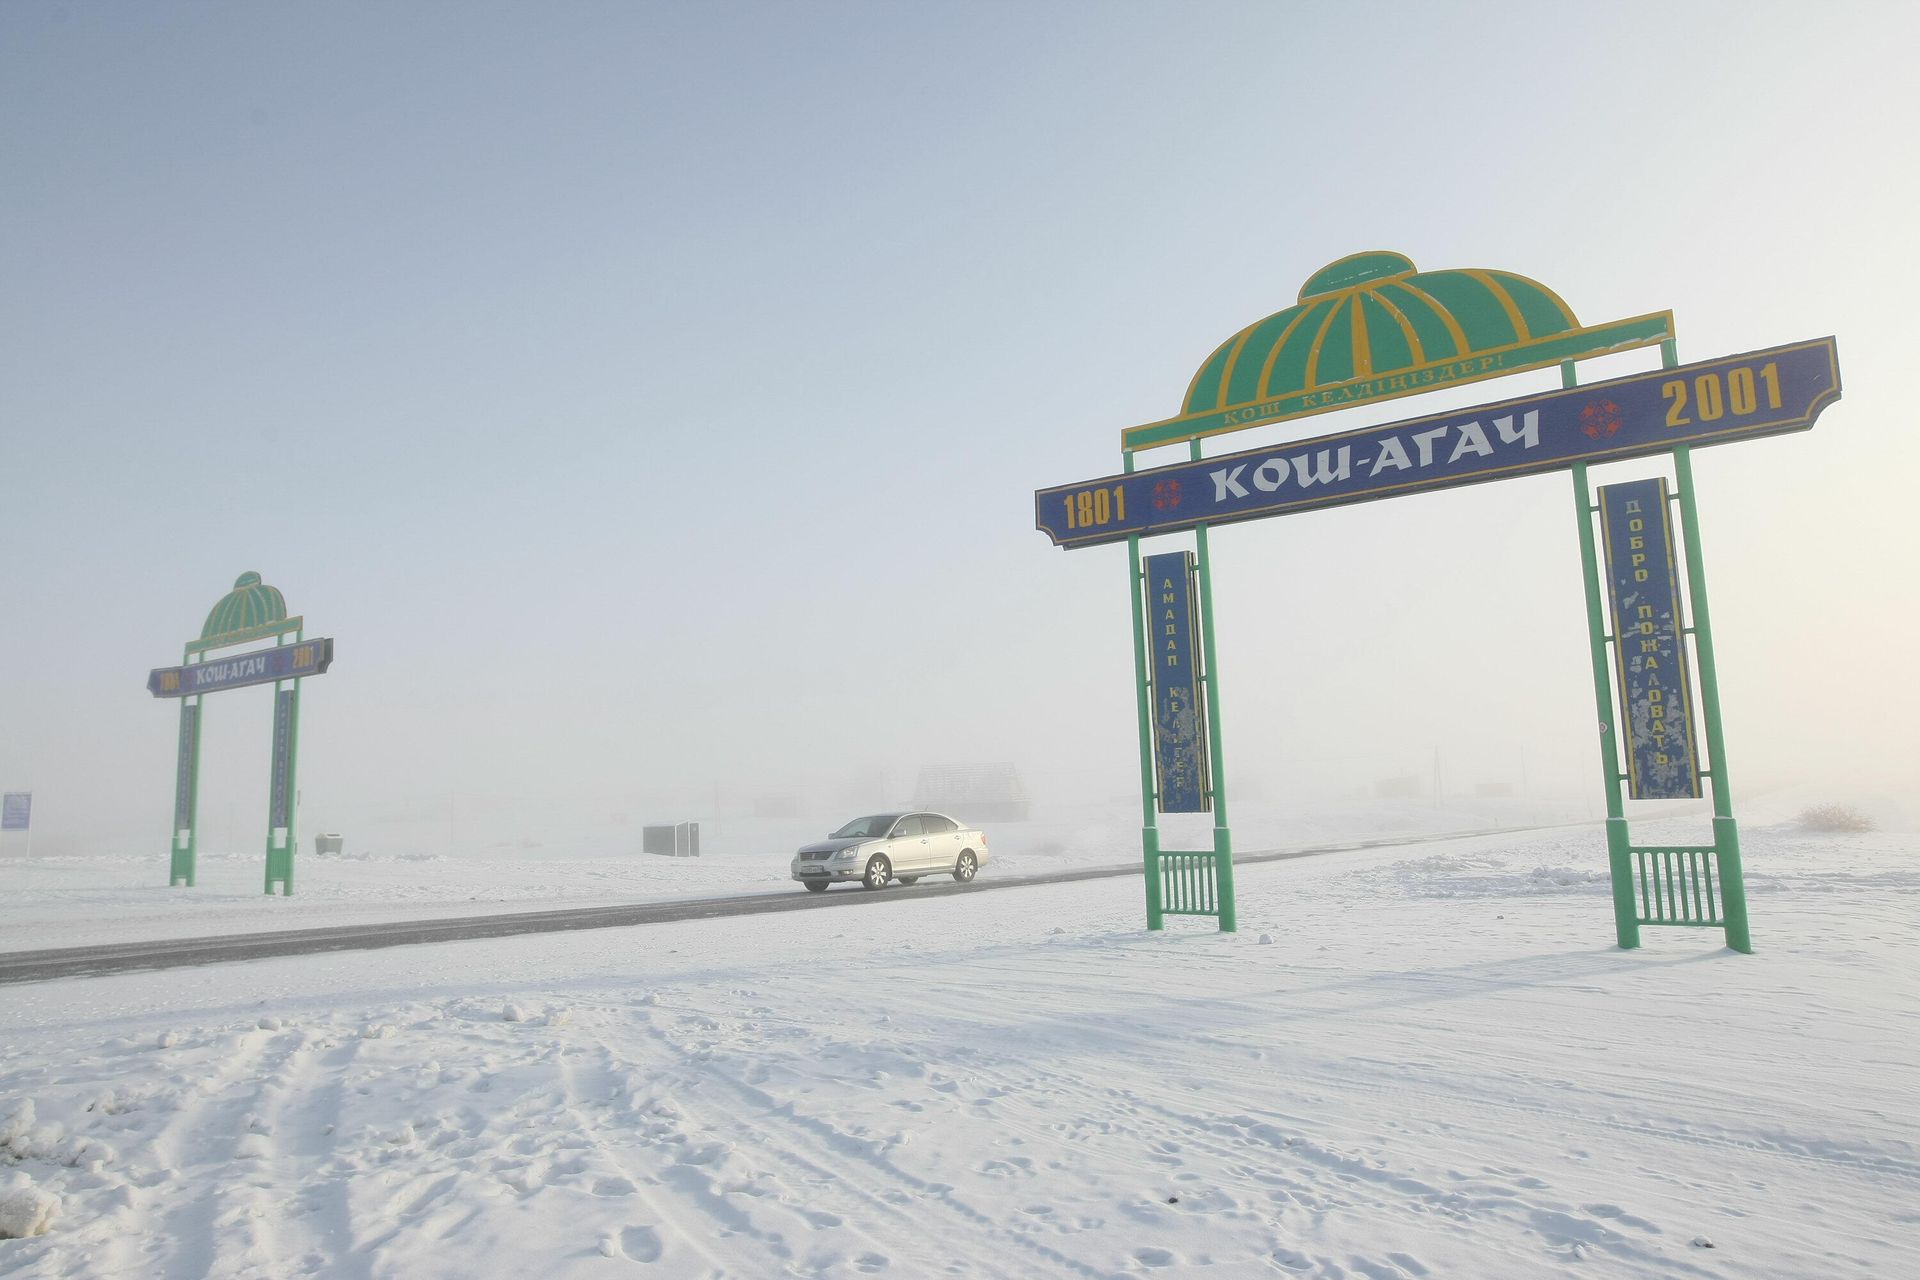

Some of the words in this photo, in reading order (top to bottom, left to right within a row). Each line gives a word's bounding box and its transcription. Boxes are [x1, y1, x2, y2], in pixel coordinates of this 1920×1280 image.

[1063, 485, 1125, 529] 1801
[1209, 409, 1540, 502] КОШ-АГАЧ
[1662, 362, 1783, 427] 2001
[196, 657, 266, 685] КОШ-АГАЧ
[1625, 499, 1649, 583] ДОБРО
[1638, 604, 1669, 766] ПОЖАЛОВАТЬ
